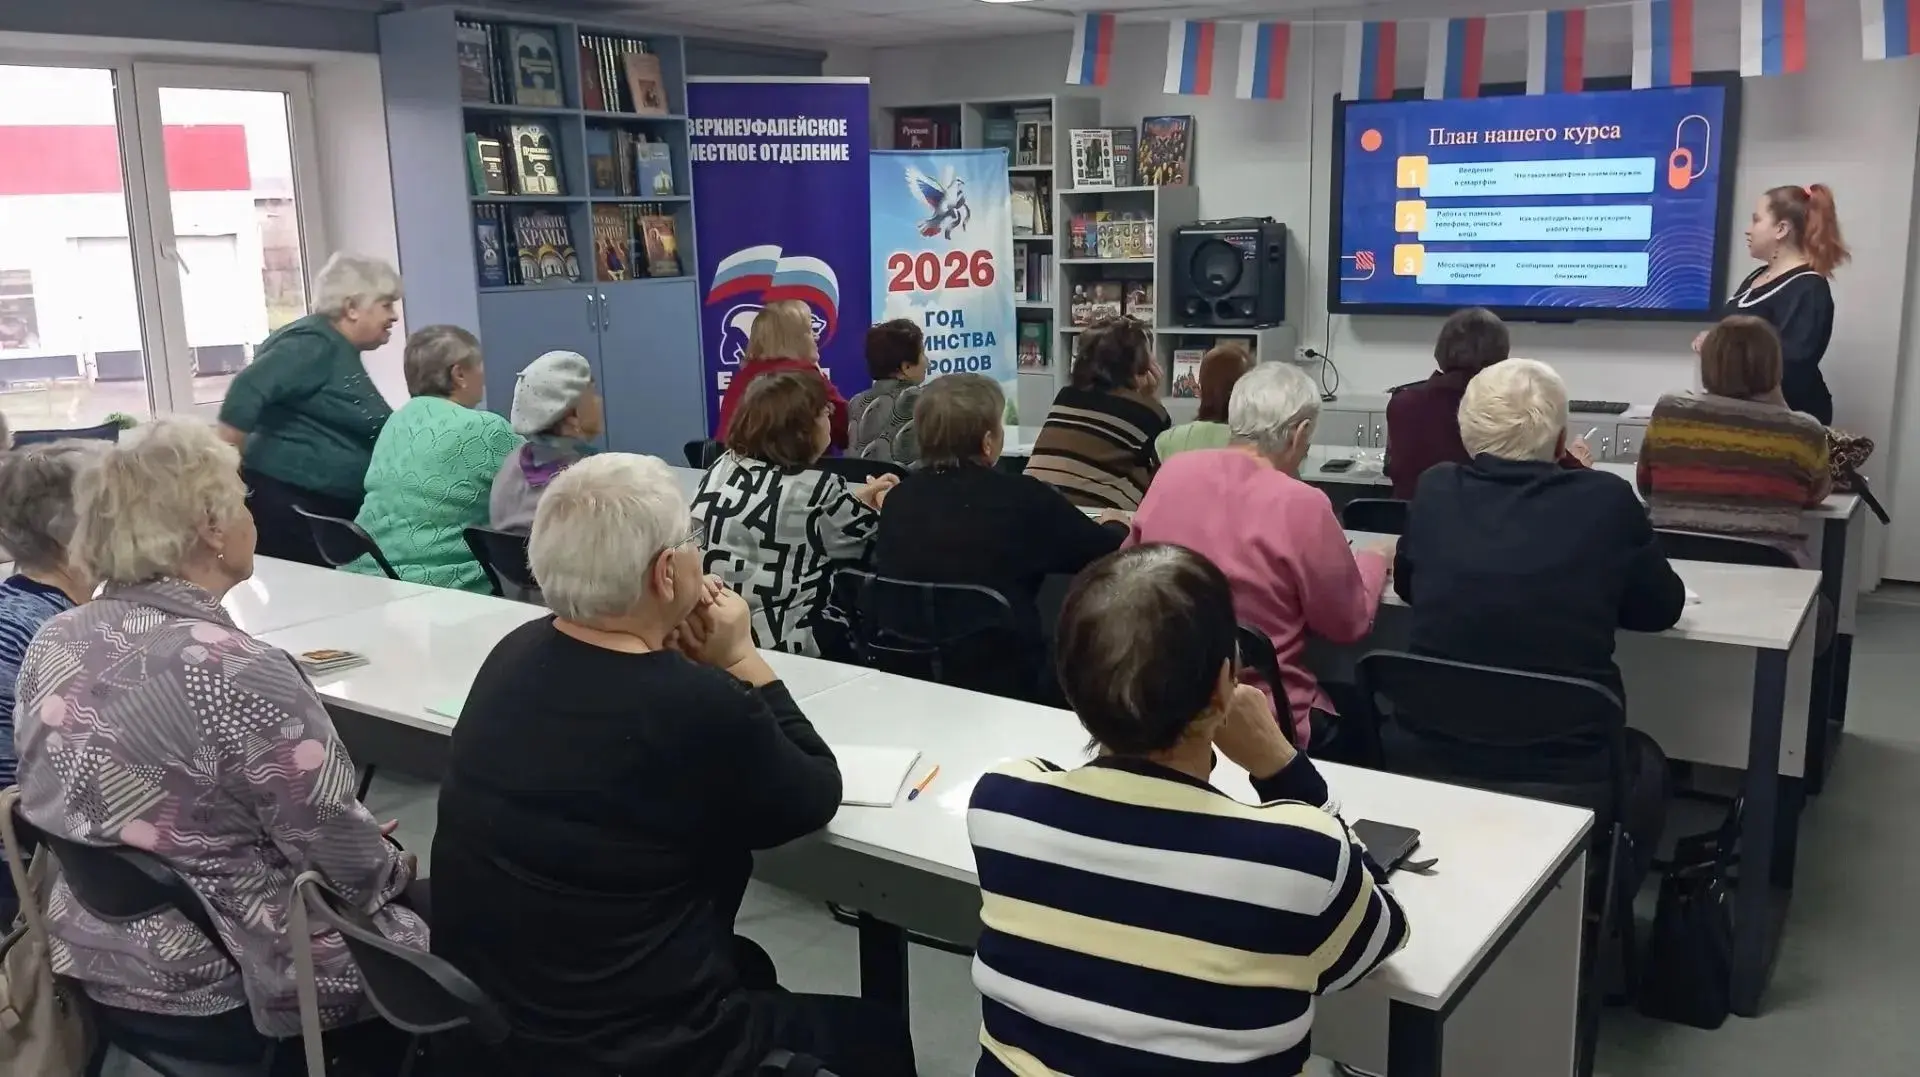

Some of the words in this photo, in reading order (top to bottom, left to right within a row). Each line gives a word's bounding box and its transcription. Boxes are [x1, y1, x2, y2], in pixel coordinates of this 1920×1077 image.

[688, 115, 848, 137] ВЕРХНЕУФАЛЕЙСКОЕ
[1428, 127, 1478, 146] План
[1484, 127, 1557, 144] нашего
[1564, 125, 1621, 145] курса
[760, 143, 850, 164] ОТДЕЛЕНИЕ
[1409, 169, 1417, 187] 1
[1404, 214, 1416, 230] 2
[887, 249, 995, 292] 2026
[1403, 257, 1415, 273] 3
[925, 309, 964, 328] ГОД
[924, 331, 996, 351] ИНСТВА
[927, 355, 992, 375] РОДОВ
